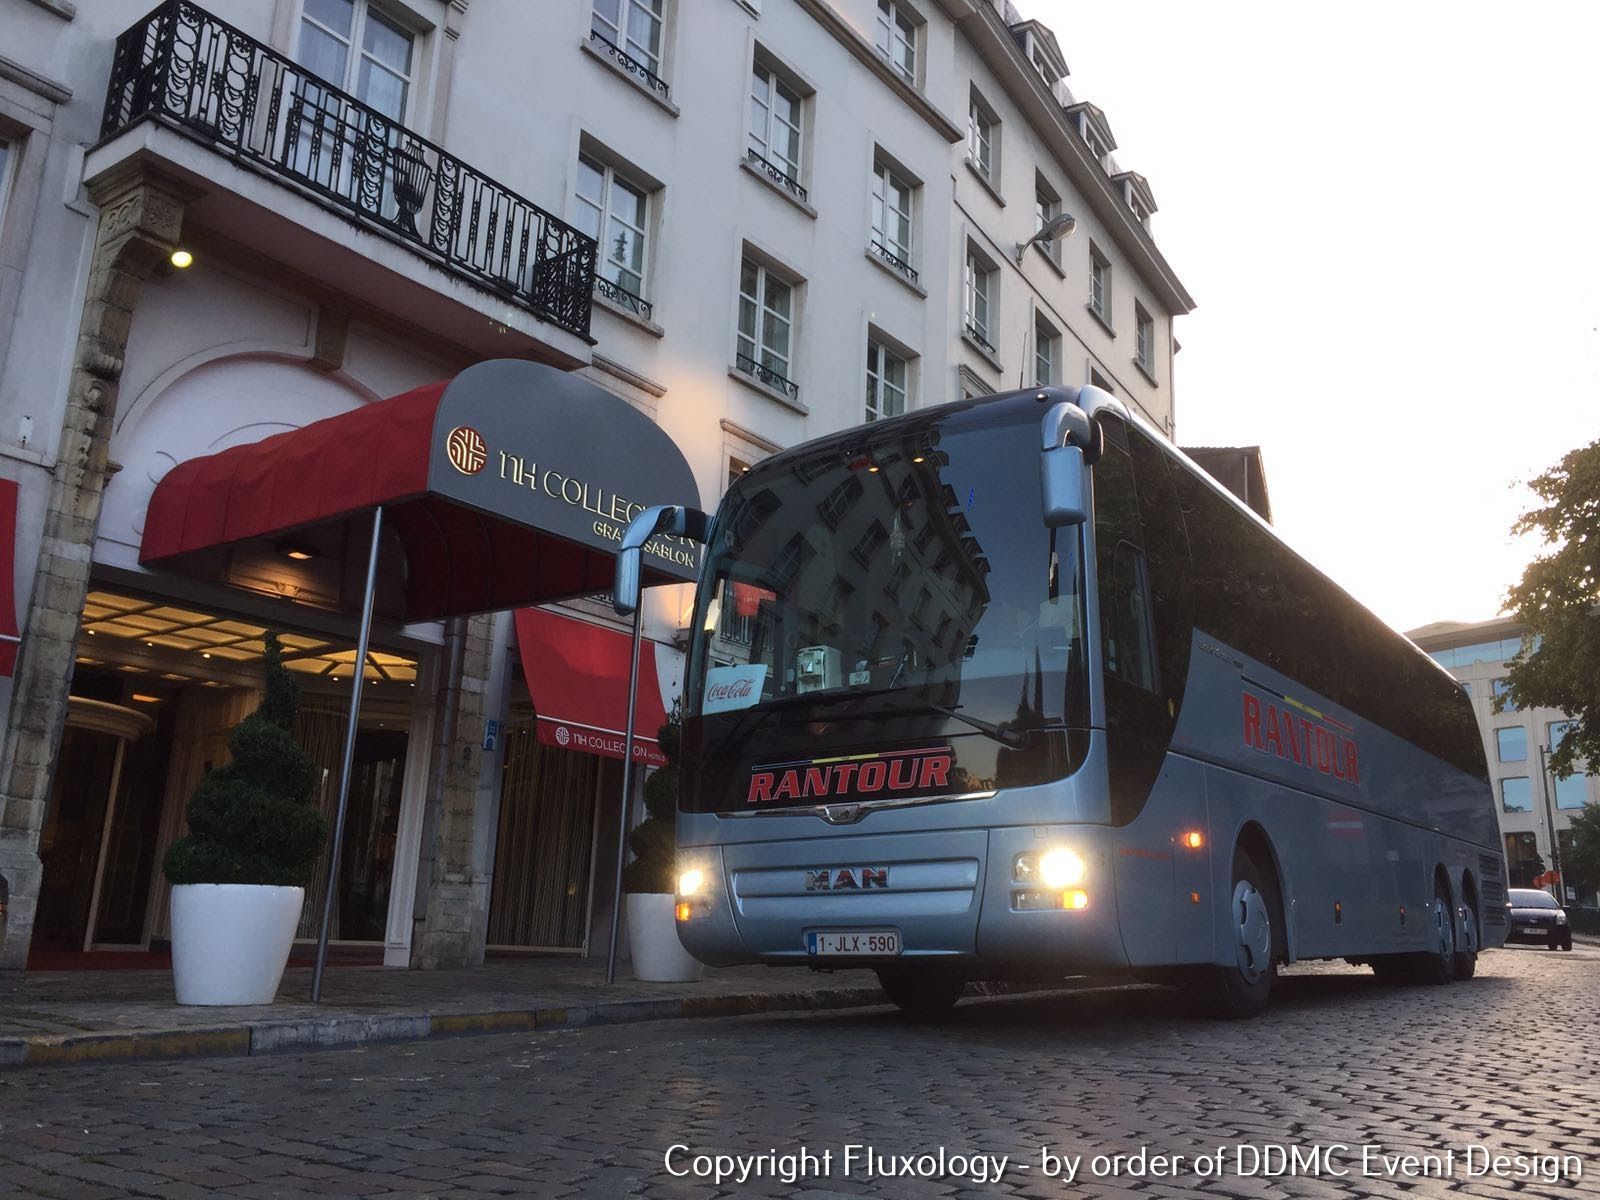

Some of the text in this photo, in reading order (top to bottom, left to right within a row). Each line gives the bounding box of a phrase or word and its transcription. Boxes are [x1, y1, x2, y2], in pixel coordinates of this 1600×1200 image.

[593, 520, 695, 568] GRA SABLON
[588, 736, 648, 757] COLLECON
[1242, 692, 1361, 785] RANTOUR
[748, 755, 951, 802] RANTOUR
[805, 866, 890, 891] MAN
